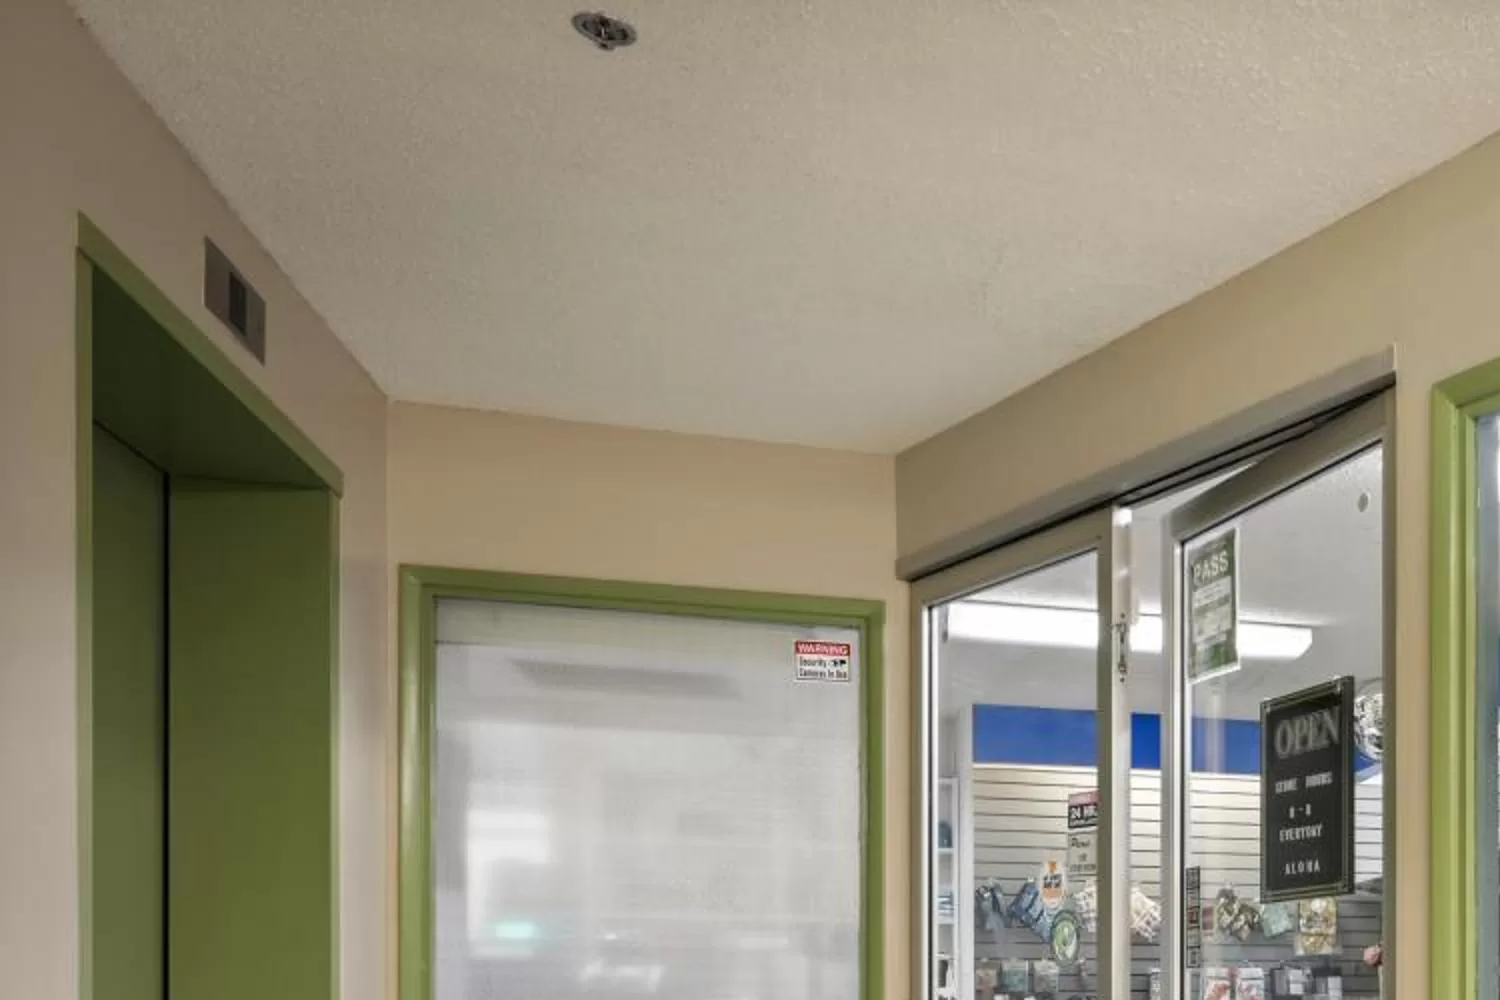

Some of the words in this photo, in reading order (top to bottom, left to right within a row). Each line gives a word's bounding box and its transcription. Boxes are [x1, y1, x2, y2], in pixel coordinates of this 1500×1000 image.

[1193, 550, 1229, 587] PASS
[798, 643, 849, 655] WARNING
[1275, 705, 1341, 759] OPEN
